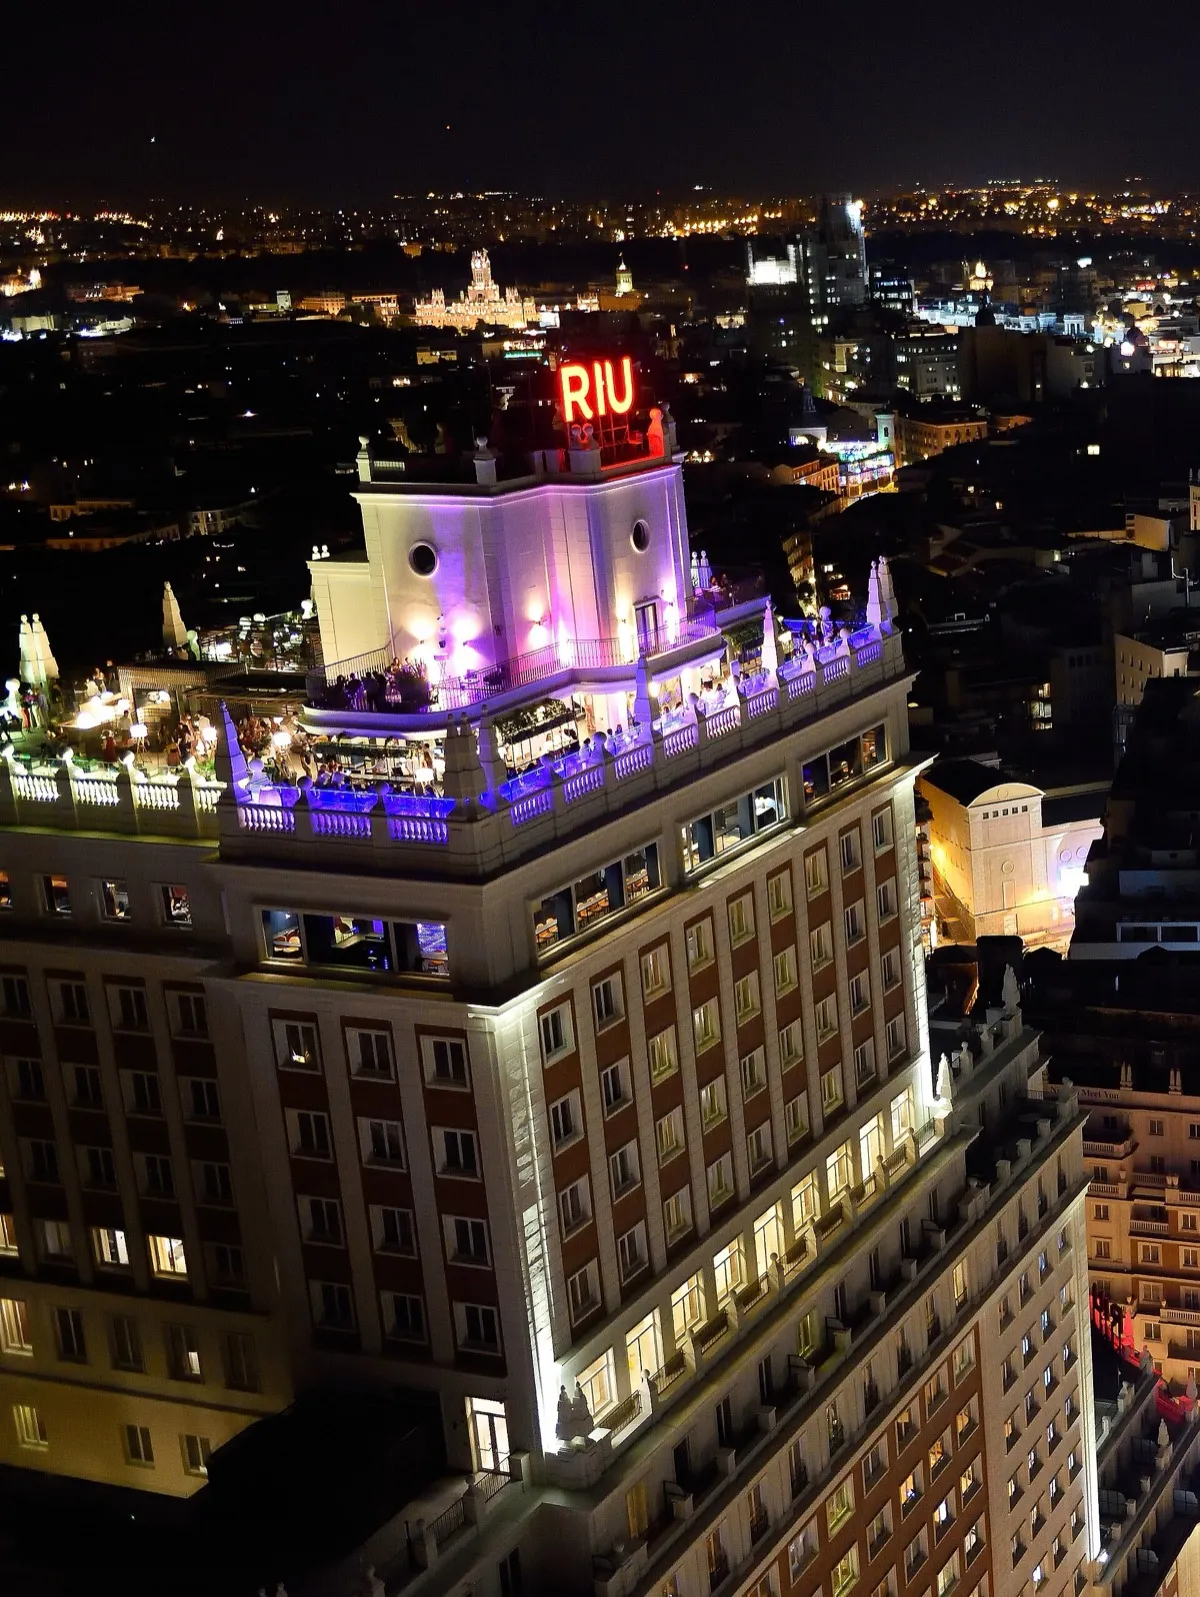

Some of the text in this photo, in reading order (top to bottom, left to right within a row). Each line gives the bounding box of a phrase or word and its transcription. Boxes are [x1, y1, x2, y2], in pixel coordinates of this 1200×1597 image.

[561, 357, 632, 422] RIU
[1082, 1089, 1101, 1098] Meet
[1104, 1091, 1119, 1099] You
